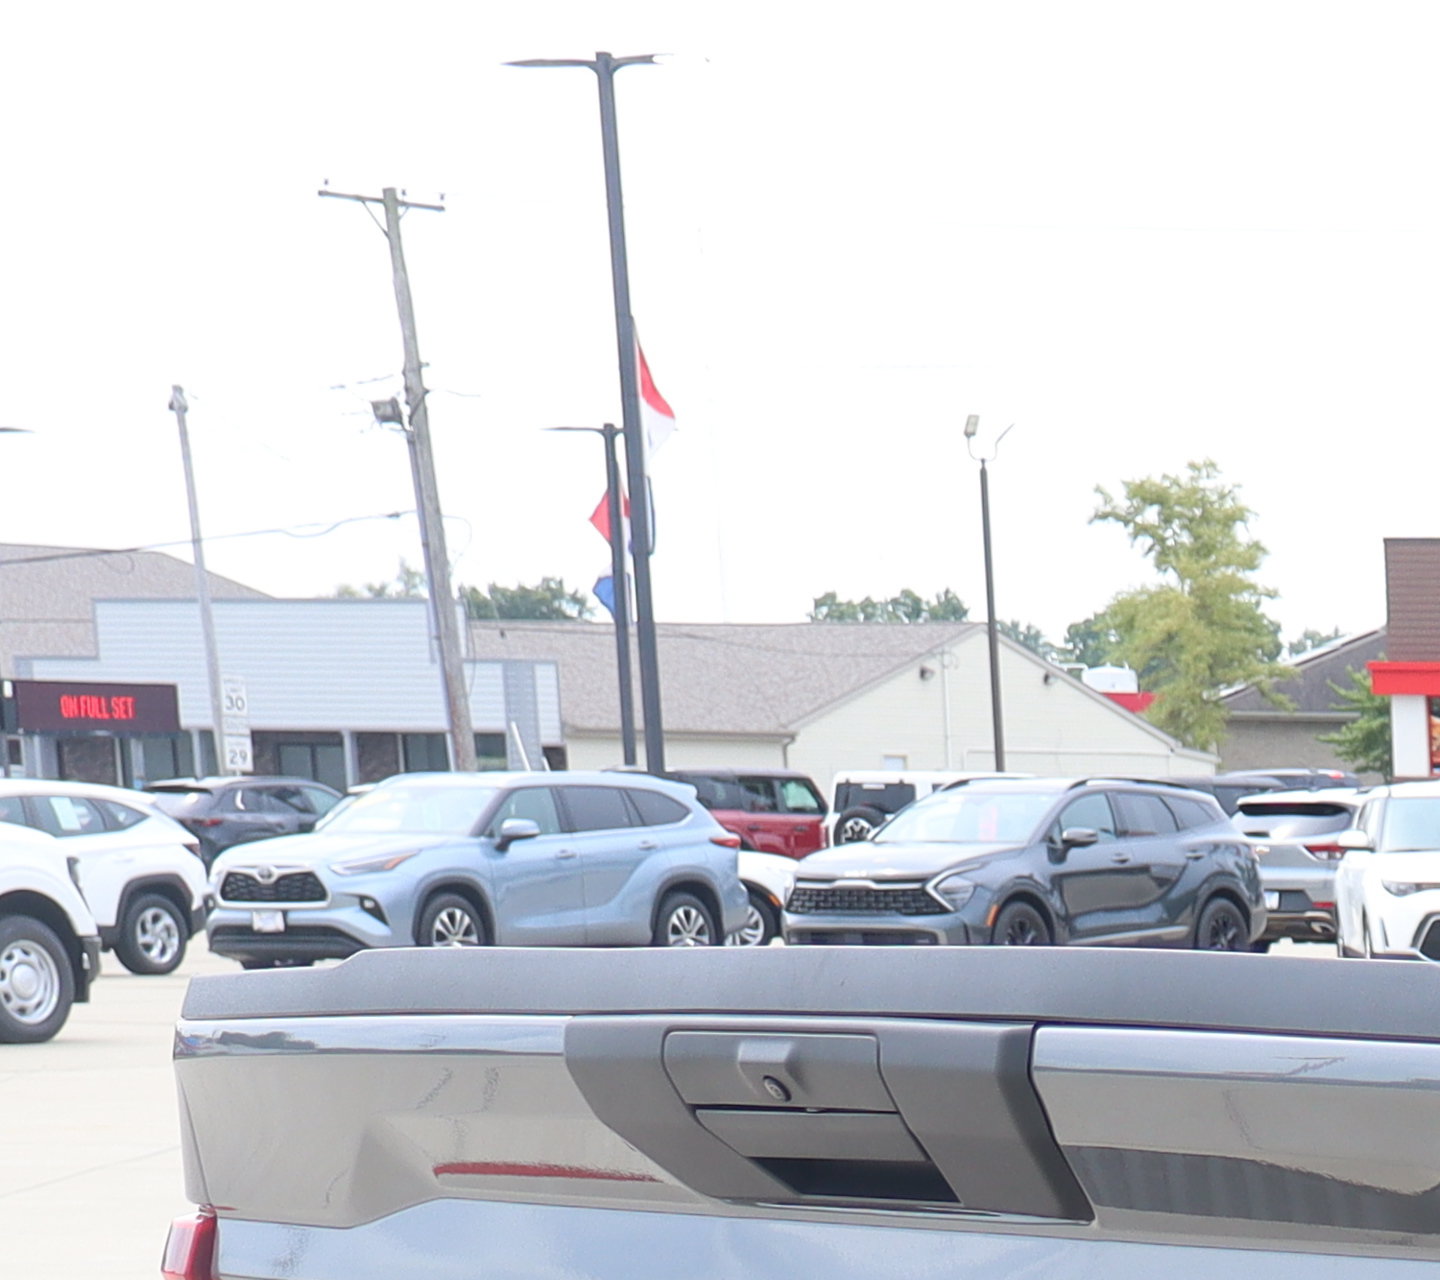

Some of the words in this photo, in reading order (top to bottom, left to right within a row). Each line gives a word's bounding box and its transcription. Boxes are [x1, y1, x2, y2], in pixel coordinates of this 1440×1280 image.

[80, 695, 111, 719] FULL
[111, 696, 134, 719] SET
[225, 695, 246, 711] 30
[228, 748, 248, 765] 29
